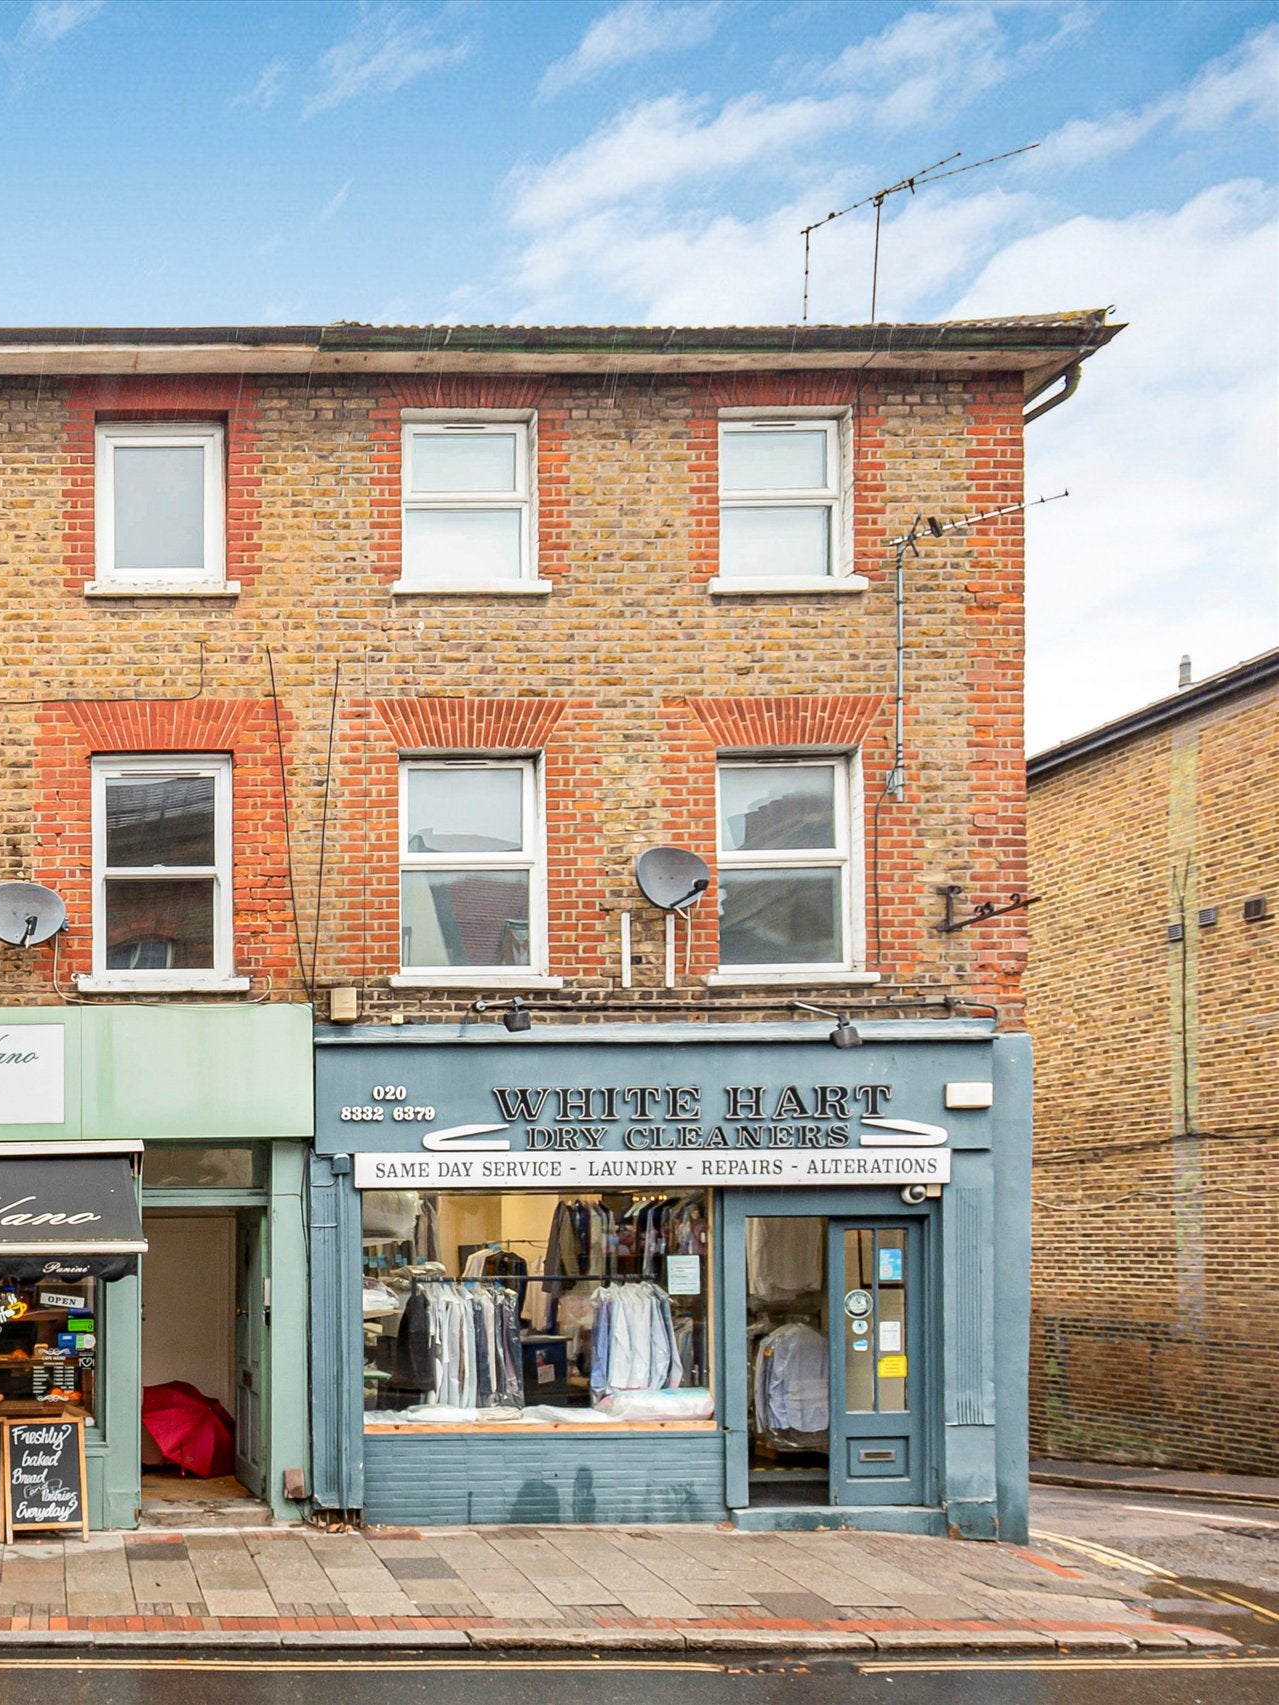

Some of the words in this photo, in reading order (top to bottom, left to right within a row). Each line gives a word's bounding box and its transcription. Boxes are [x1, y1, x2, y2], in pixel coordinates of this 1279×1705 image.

[373, 1085, 407, 1100] 020
[493, 1083, 702, 1121] WHITE
[724, 1084, 893, 1120] HART
[340, 1106, 384, 1121] 8332
[392, 1106, 436, 1121] 6379
[526, 1125, 608, 1150] DRY
[624, 1123, 851, 1150] CLEANERS
[375, 1162, 429, 1179] SAME
[438, 1161, 473, 1178] DAY
[482, 1161, 561, 1177] SERVICE
[588, 1160, 677, 1176] LAUNDRY
[702, 1159, 783, 1176] REPAIRS
[807, 1157, 937, 1174] ALTERATIONS
[42, 1261, 90, 1274] Panini
[48, 1296, 76, 1306] OPEN
[11, 1424, 72, 1450] Freshly
[21, 1450, 62, 1466] baked
[12, 1467, 48, 1484] Bread
[29, 1480, 49, 1496] and
[16, 1500, 78, 1521] Everyday
